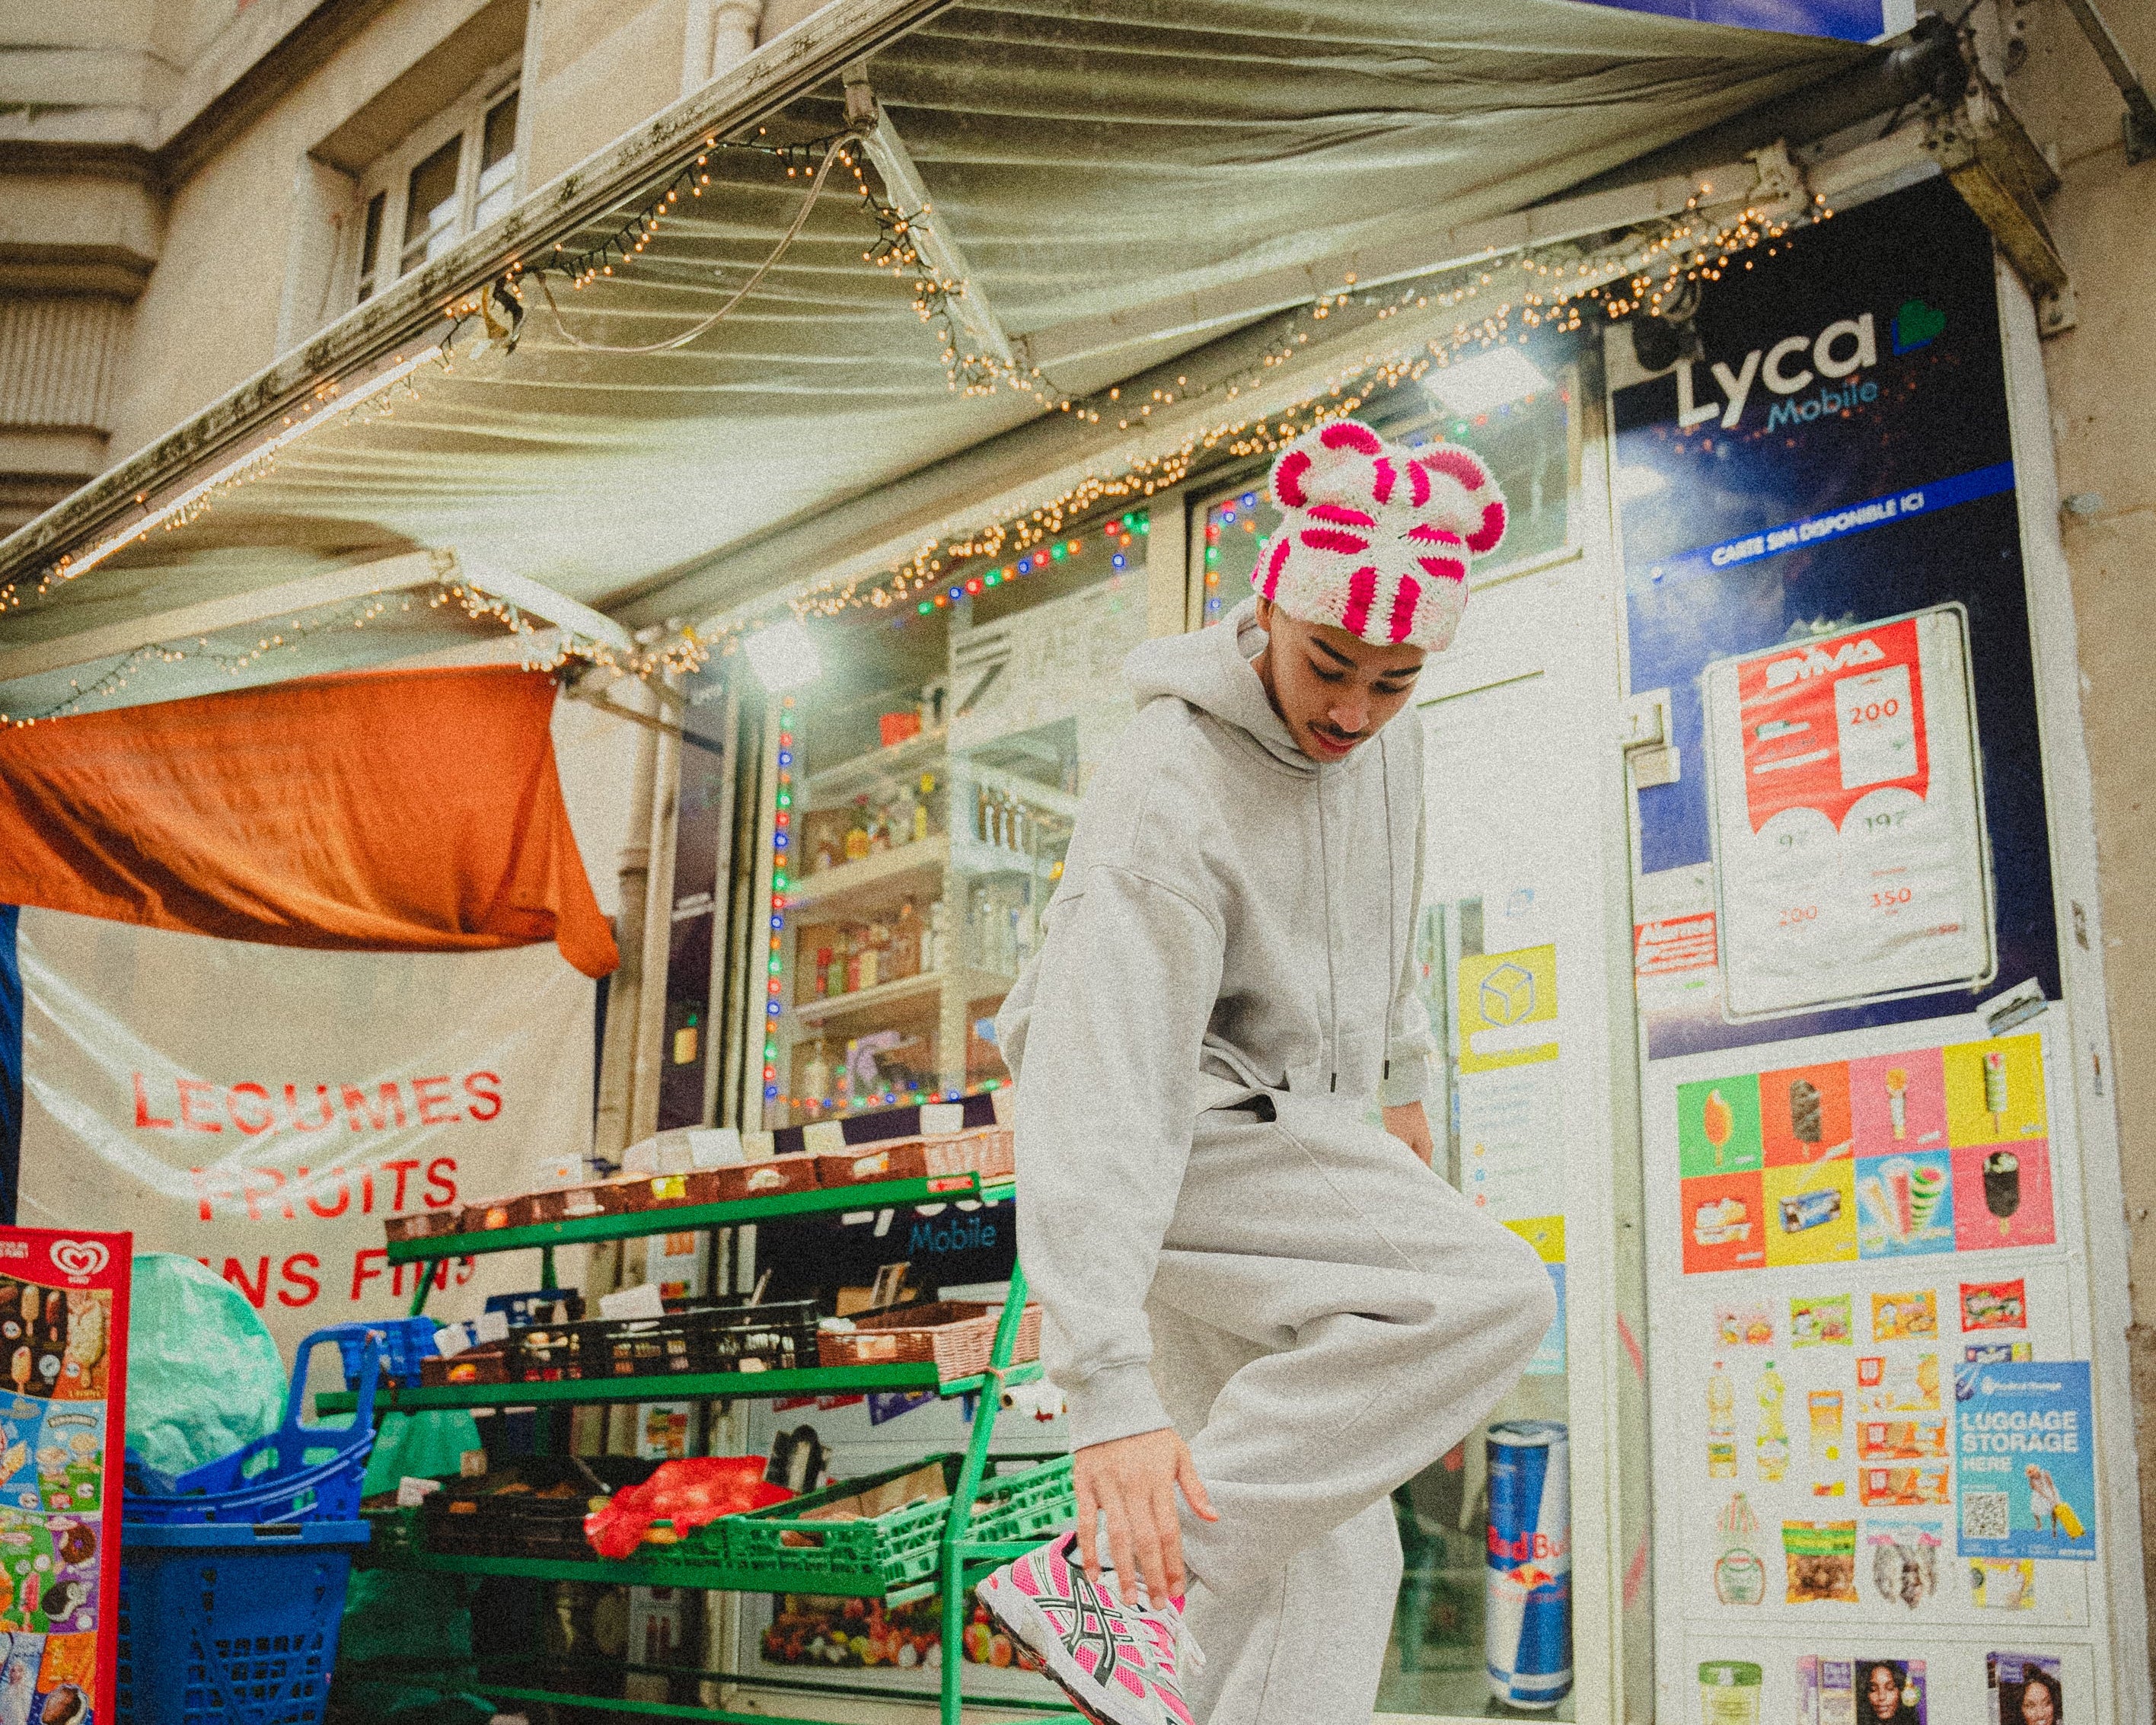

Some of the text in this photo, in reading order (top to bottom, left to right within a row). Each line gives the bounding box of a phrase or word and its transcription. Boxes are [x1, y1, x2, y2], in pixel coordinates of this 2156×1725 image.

[1674, 313, 1877, 428] Lyca
[1767, 381, 1878, 434] Mobile
[1848, 698, 1899, 726] 200
[1871, 887, 1912, 908] 350
[133, 1070, 503, 1136] LEGUMES
[190, 1157, 458, 1221] FRUITS
[907, 1217, 997, 1255] Mobile
[196, 1252, 320, 1309] NS
[1961, 1411, 2078, 1431] LUGGAGE
[1961, 1433, 2079, 1452] STORAGE
[1961, 1456, 2012, 1472] HERE
